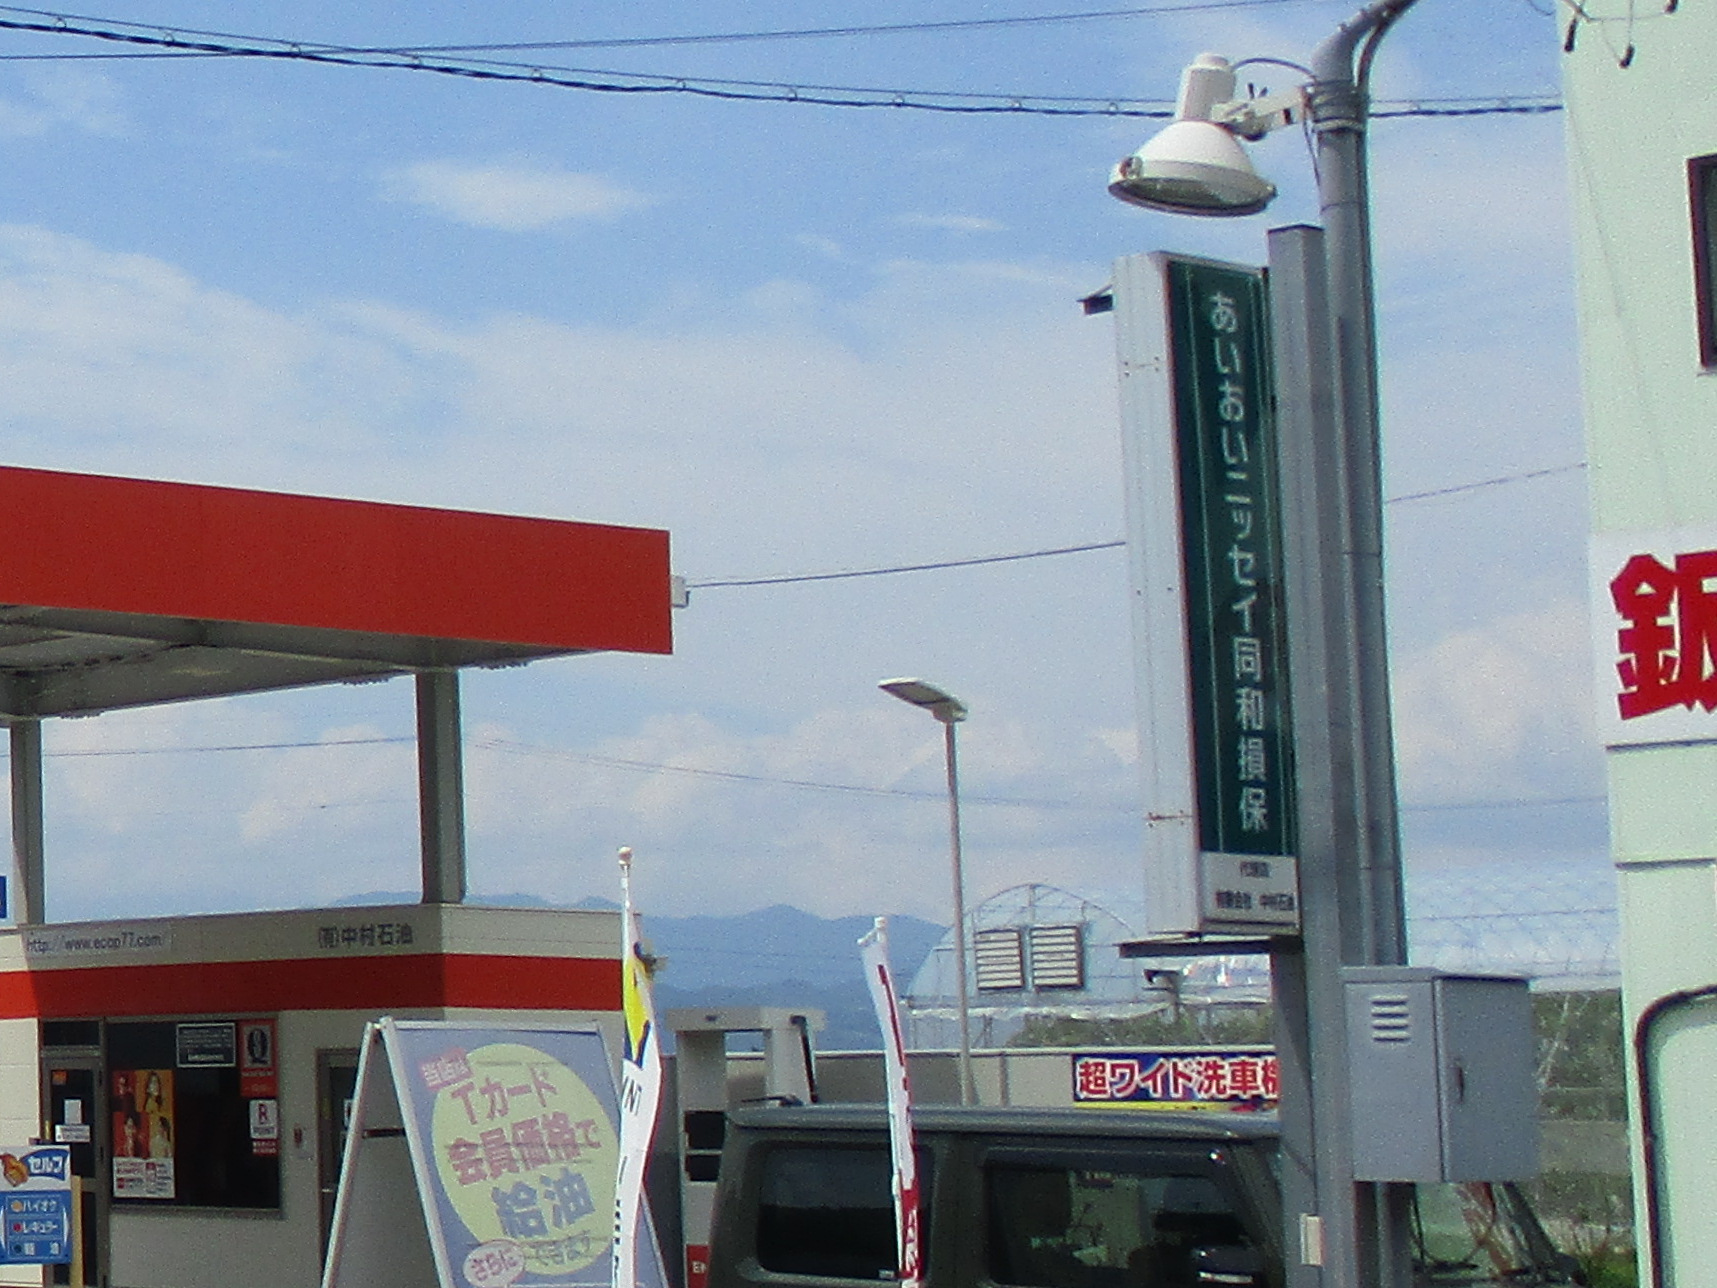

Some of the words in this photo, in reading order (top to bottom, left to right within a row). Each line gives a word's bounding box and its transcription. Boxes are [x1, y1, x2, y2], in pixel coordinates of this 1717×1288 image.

[1211, 290, 1269, 833] あいおいニッセイ同和損保
[28, 1155, 64, 1174] セルフ
